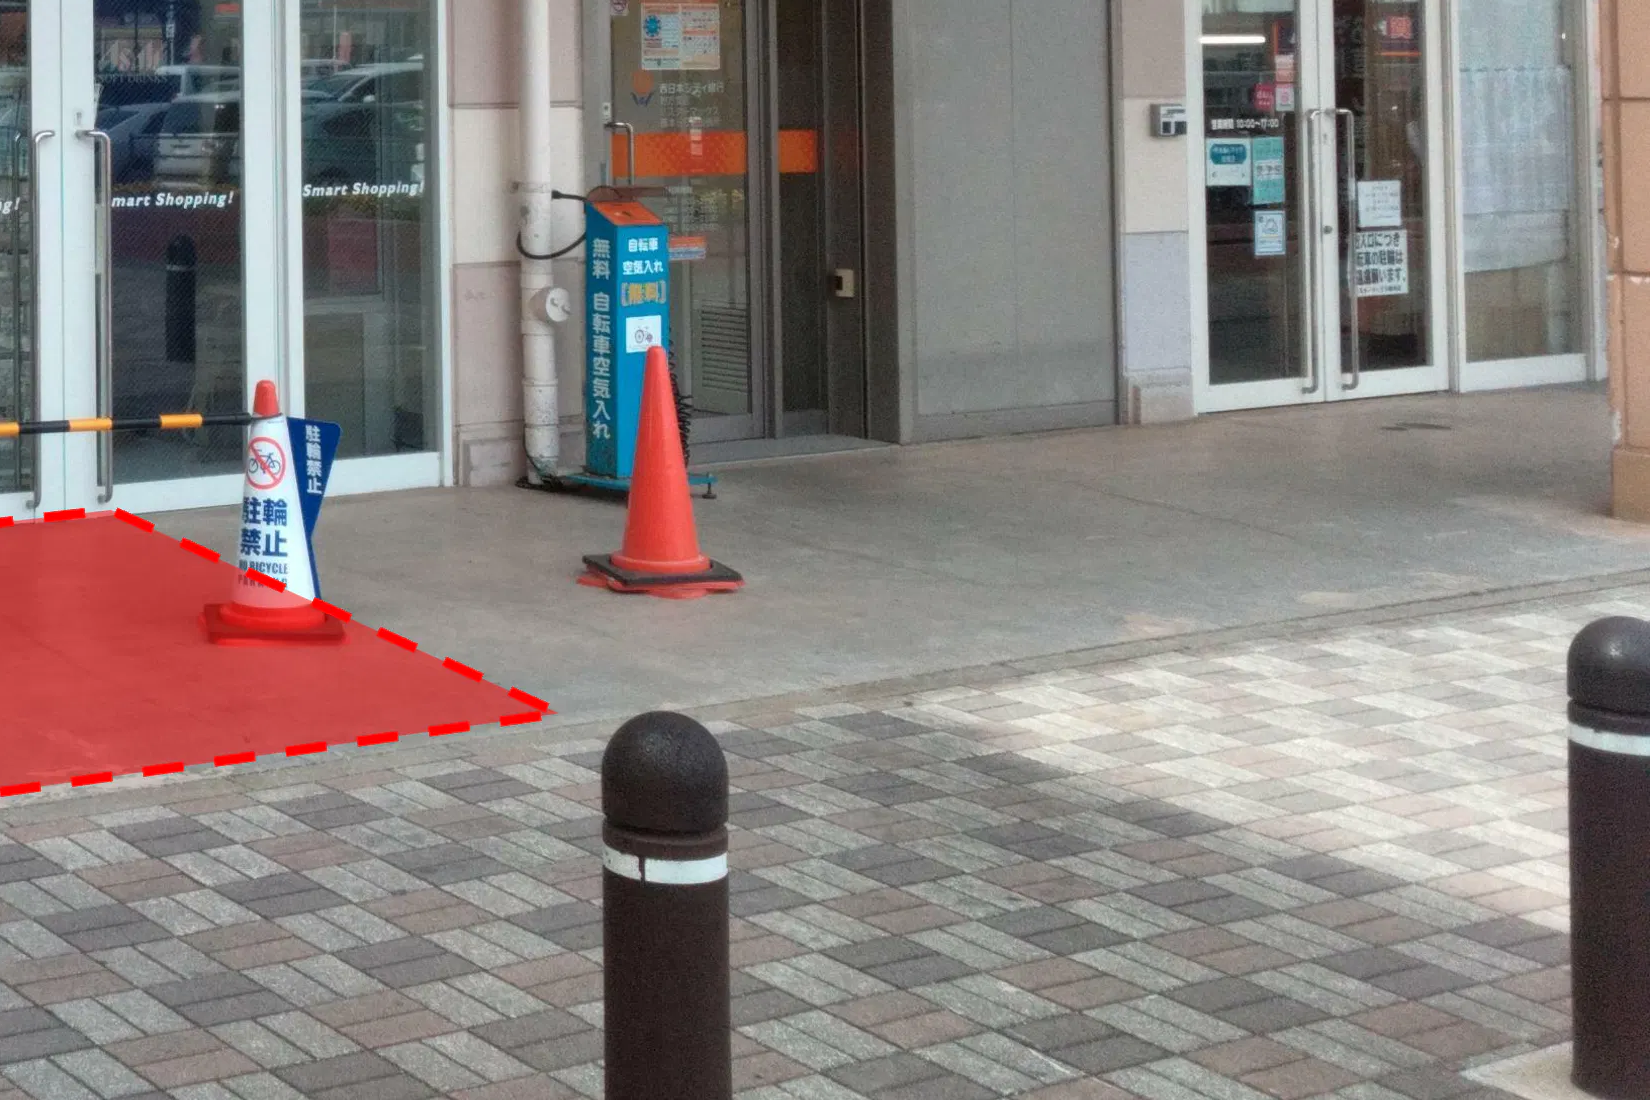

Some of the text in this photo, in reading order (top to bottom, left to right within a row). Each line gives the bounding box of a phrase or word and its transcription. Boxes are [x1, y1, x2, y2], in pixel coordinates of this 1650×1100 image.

[111, 190, 234, 209] mart Shopping!
[302, 177, 425, 198] Smart Shopping!
[627, 237, 659, 253] 自転車
[592, 238, 611, 281] 無料
[622, 258, 664, 276] 空気入れ
[592, 292, 611, 440] 自転車空気入れ
[305, 424, 323, 495] 駐輪禁止
[242, 497, 288, 527] 駐輪
[240, 529, 288, 557] 禁止
[249, 561, 289, 575] BICYCLE
